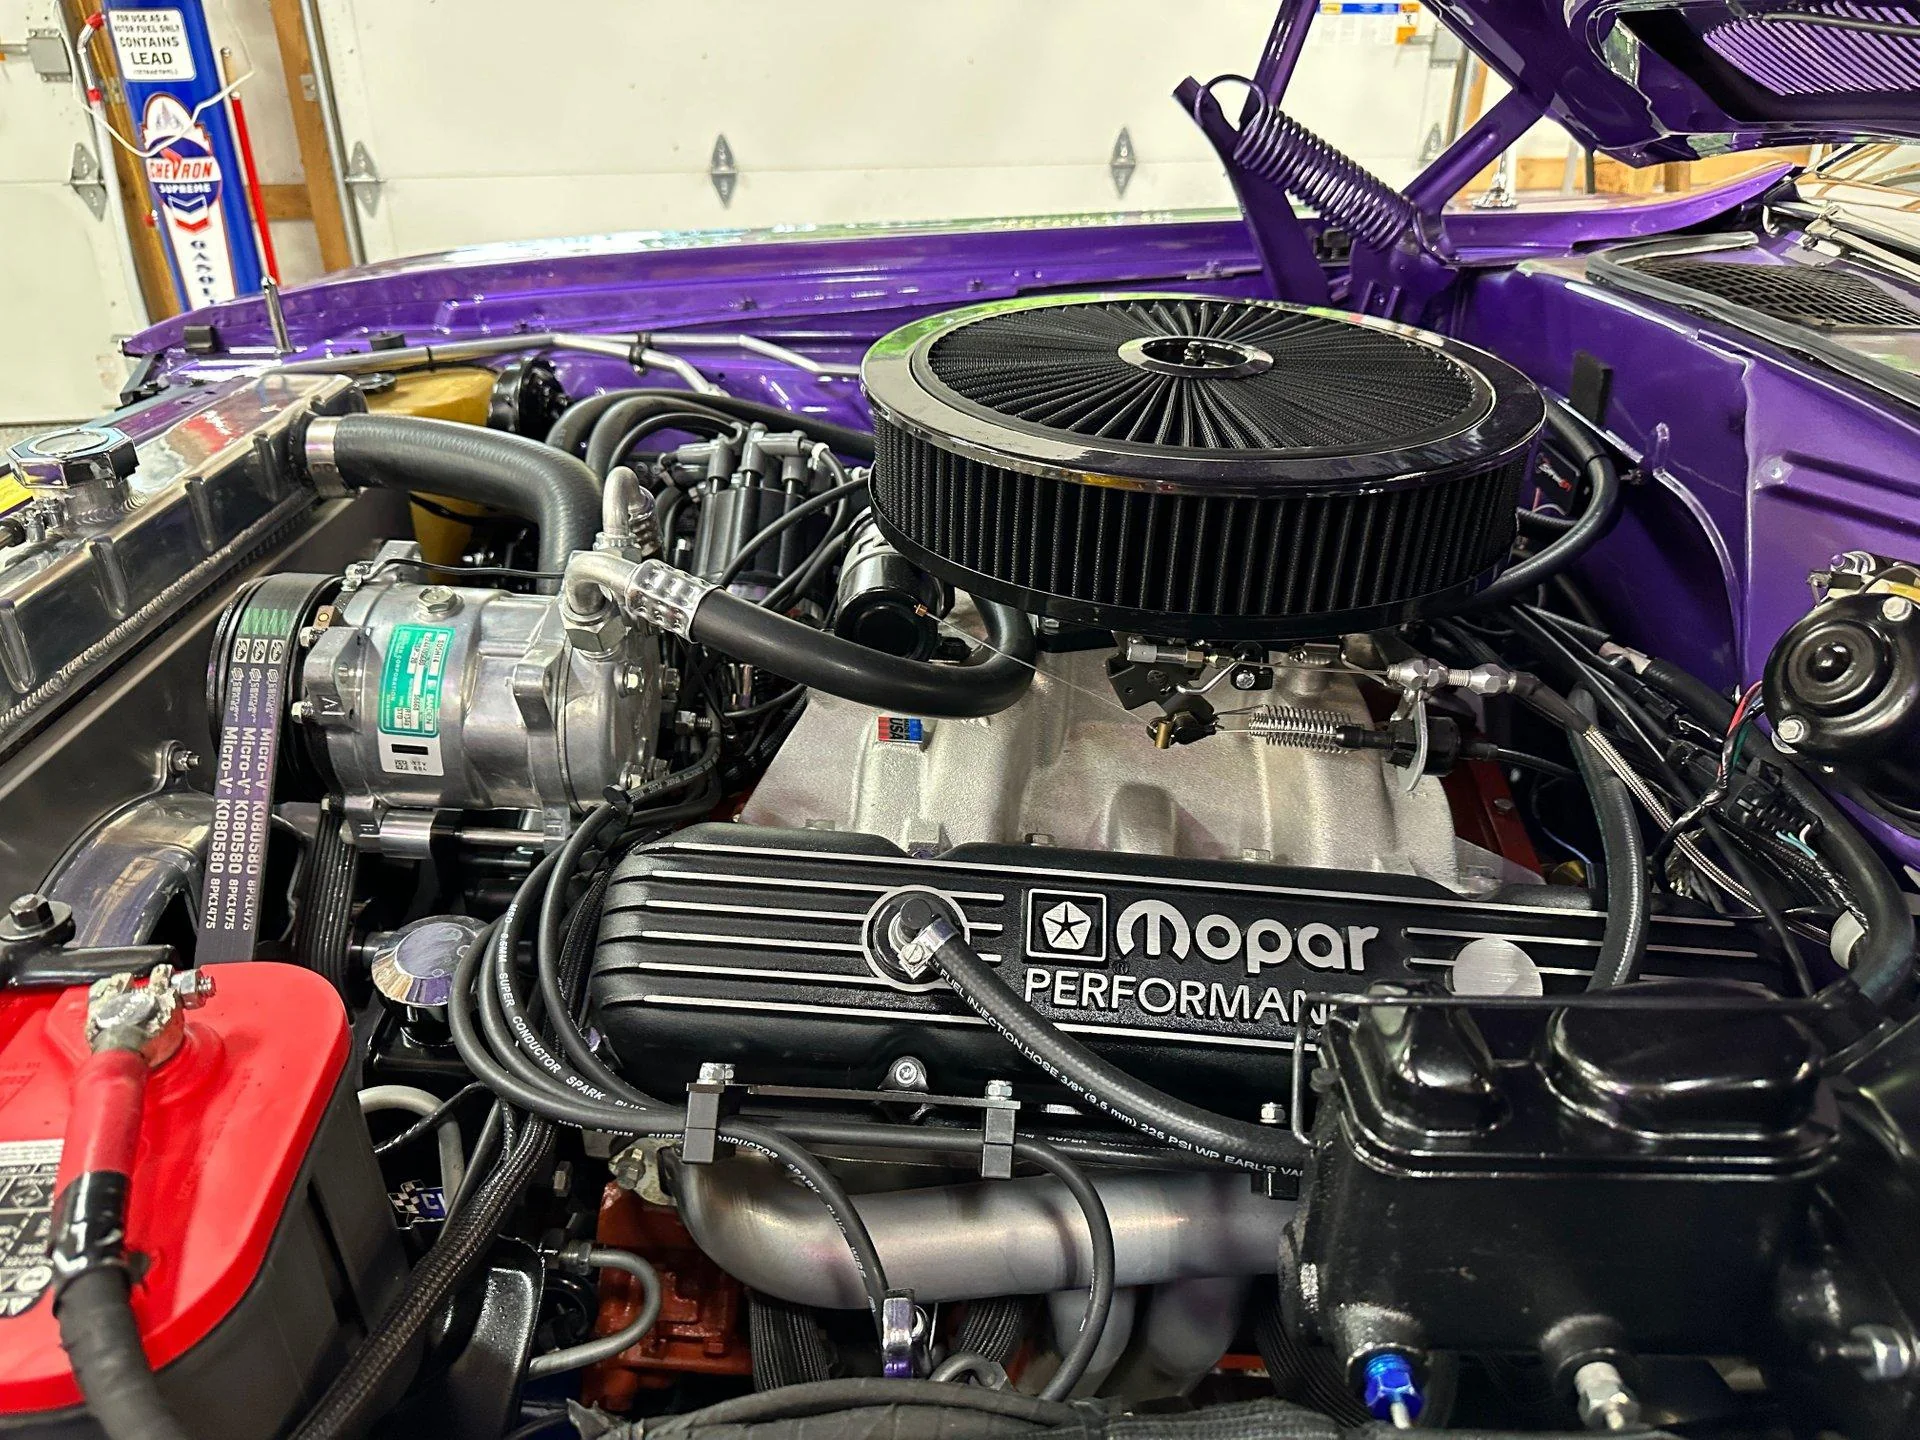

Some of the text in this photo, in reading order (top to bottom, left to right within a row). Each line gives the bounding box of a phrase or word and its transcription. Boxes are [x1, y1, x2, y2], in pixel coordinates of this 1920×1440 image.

[119, 36, 180, 48] CONTAINS
[136, 25, 158, 33] FUEL
[130, 51, 173, 66] LEAD
[149, 160, 213, 180] CHEVRON
[158, 183, 212, 194] SUPREME
[889, 717, 904, 740] USA
[209, 799, 231, 874] K080580
[228, 800, 249, 875] K080580
[246, 800, 265, 875] K080580
[205, 878, 221, 930] 8PK1475
[224, 878, 240, 930] 8PK1475
[242, 879, 257, 931] 8PK1475
[505, 903, 519, 924] MSD
[1116, 899, 1379, 974] Mopar
[498, 972, 516, 1008] SUPER
[1024, 967, 1338, 1026] PERFORMAN
[512, 1015, 562, 1074] CONDUCTOR
[565, 1076, 606, 1101] SPARK
[939, 968, 965, 998] FUEL
[966, 995, 1024, 1050] INJECTION
[1024, 1046, 1060, 1077] HOSE
[1110, 1108, 1138, 1127] mm)
[1168, 1135, 1192, 1150] PSI
[1224, 1155, 1277, 1174] EARL'S
[717, 1135, 779, 1159] ONDUCTOR
